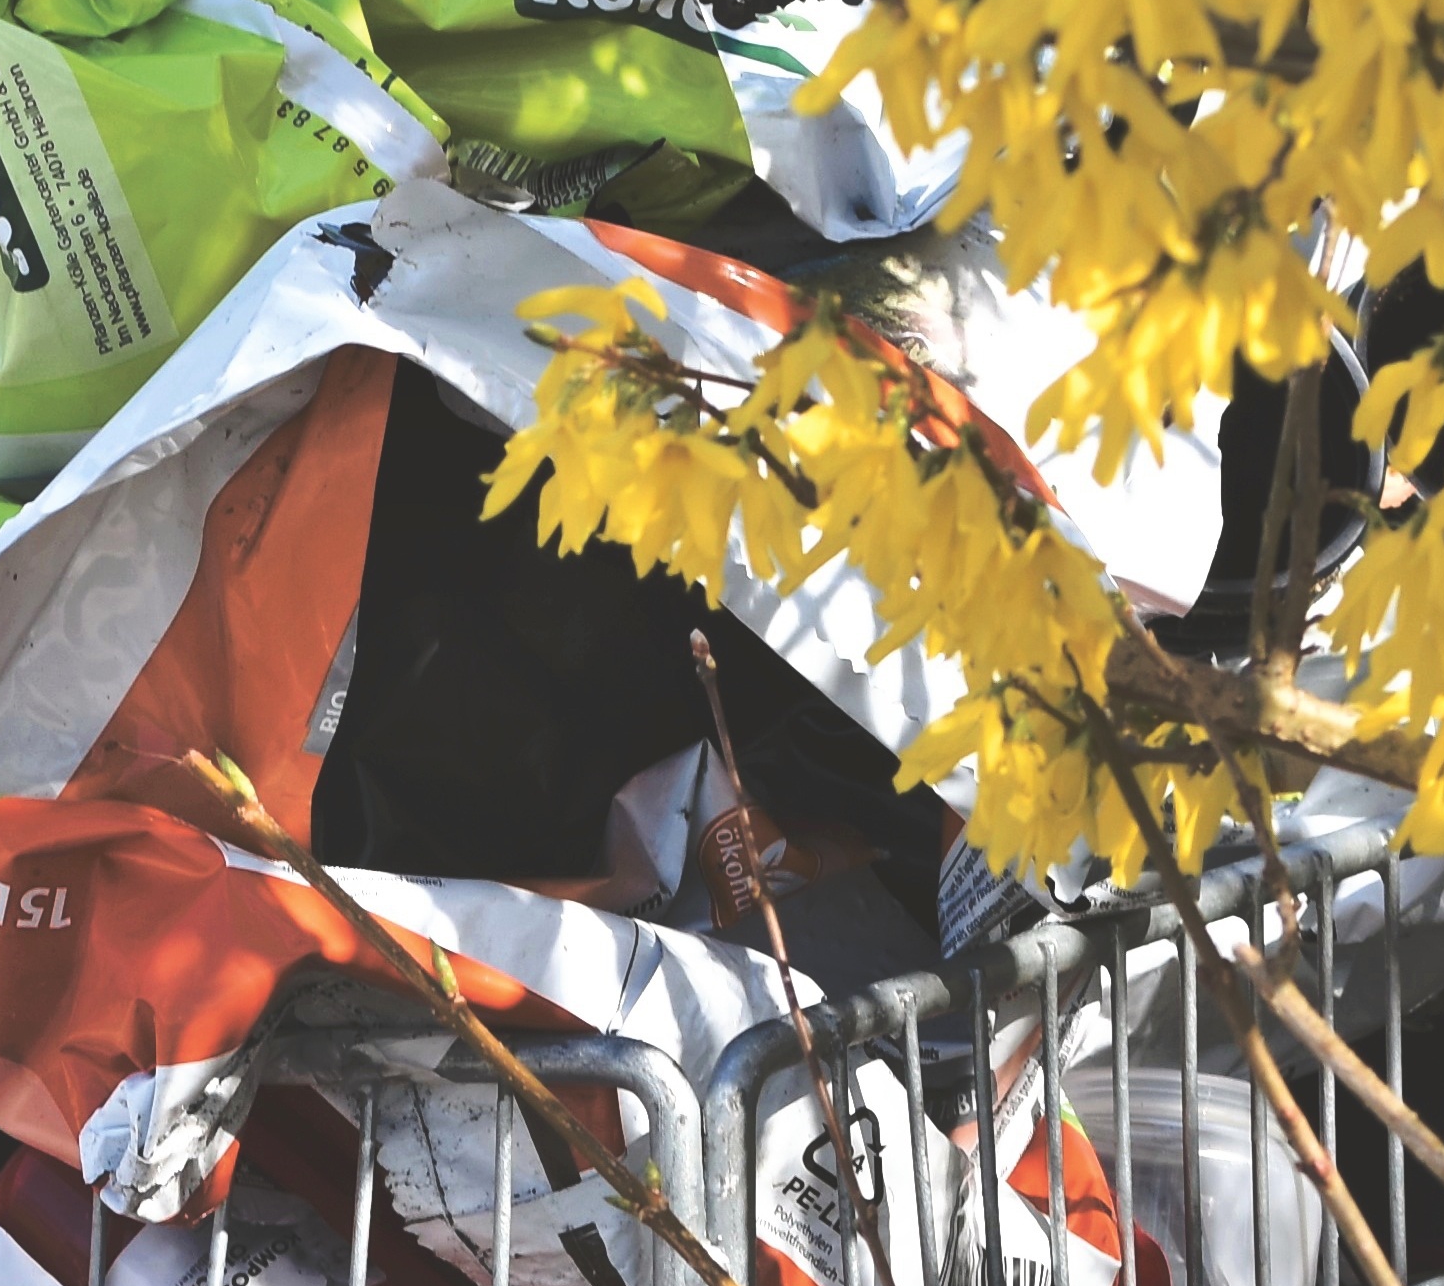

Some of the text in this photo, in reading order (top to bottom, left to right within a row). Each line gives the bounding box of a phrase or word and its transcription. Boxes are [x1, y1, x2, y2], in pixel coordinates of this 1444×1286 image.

[8, 62, 133, 347] Im Neckargarten 6 74078 Heilbronn
[20, 150, 73, 251] Gartencenter
[60, 251, 114, 355] Pflanzen-Kölle
[74, 166, 153, 338] www.pflanzen-koelle.de
[754, 1215, 839, 1282] mweltfreundlich
[772, 1204, 834, 1255] Polyethylen
